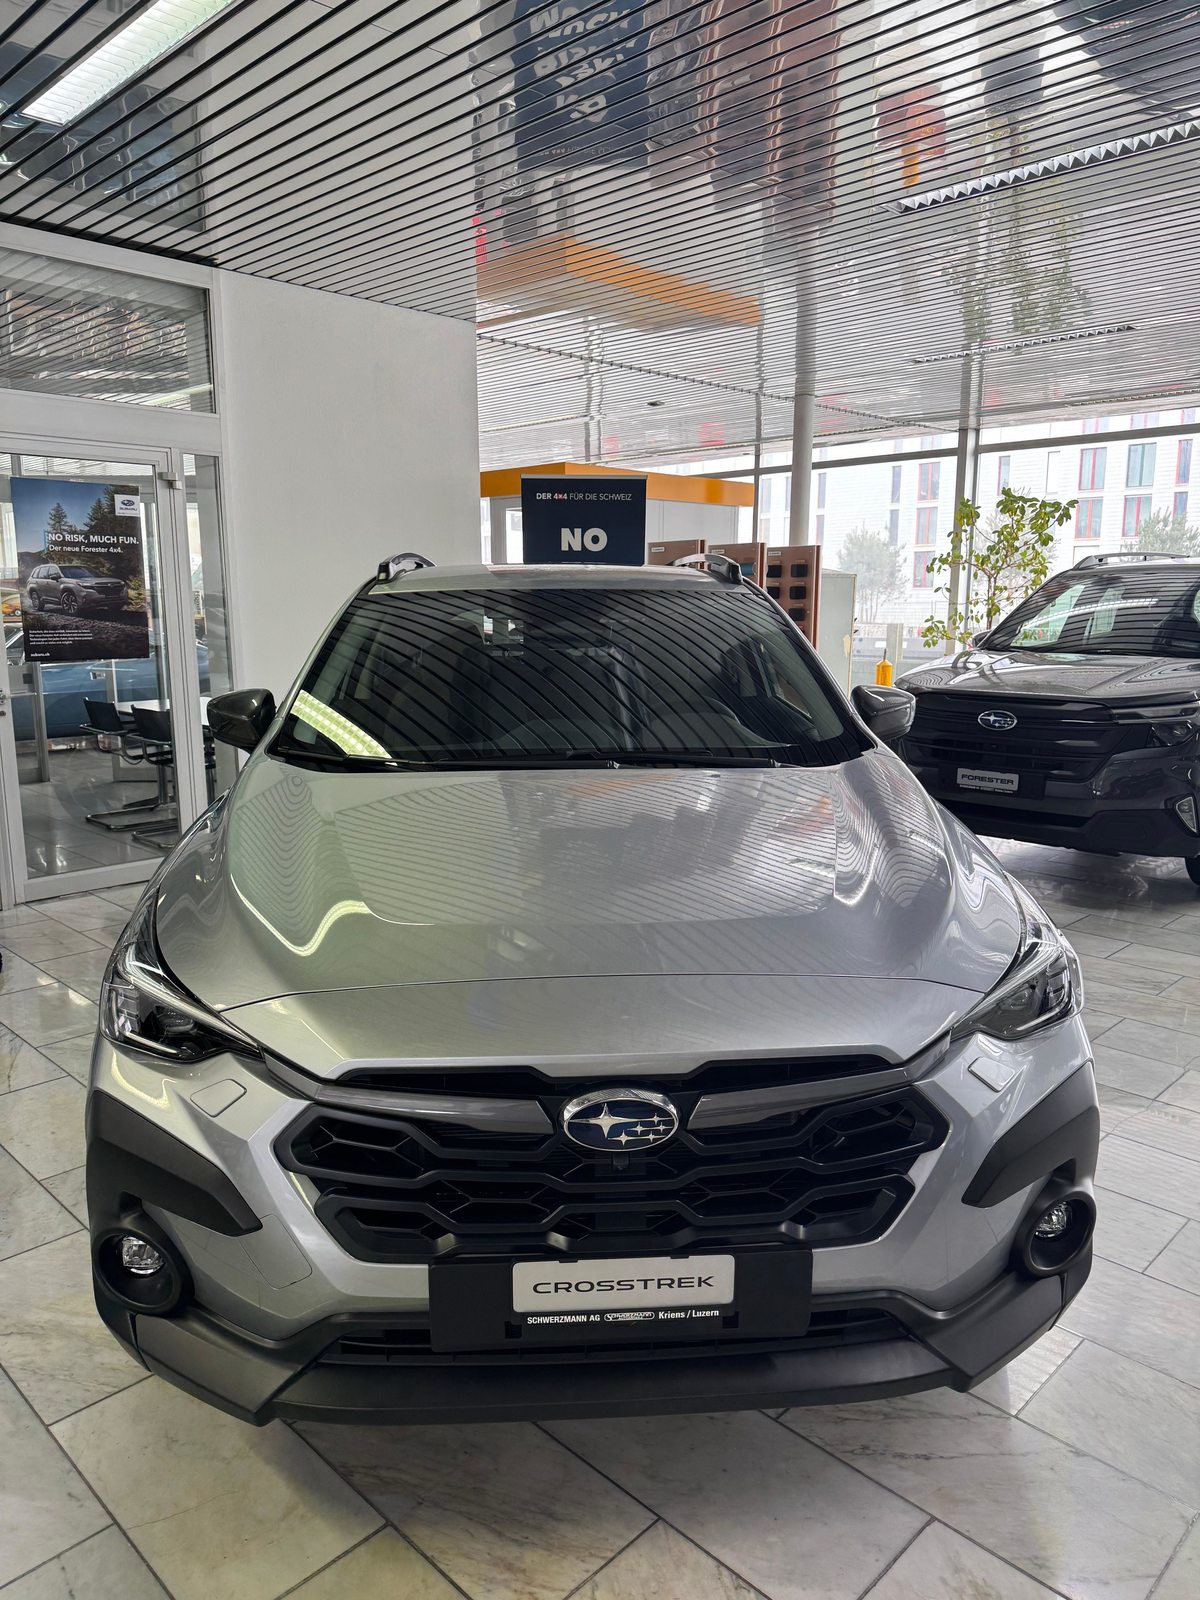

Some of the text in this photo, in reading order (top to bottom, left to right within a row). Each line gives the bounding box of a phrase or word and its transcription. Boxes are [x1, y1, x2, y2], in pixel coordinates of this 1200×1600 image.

[536, 492, 552, 500] DER
[569, 491, 584, 501] FÜR
[585, 493, 598, 501] DIE
[599, 493, 632, 501] SCHWEIZ
[48, 533, 140, 545] NO RISK, MUCH FUN.
[561, 527, 608, 552] NO
[49, 544, 62, 552] Der
[81, 545, 108, 553] Forester
[961, 774, 1014, 785] FORESTER
[532, 1275, 715, 1294] CROSSTREK
[527, 1315, 587, 1325] SCHWERZMANN
[589, 1314, 601, 1322] AG
[658, 1310, 685, 1320] Kriens
[692, 1309, 719, 1318] Luzern
